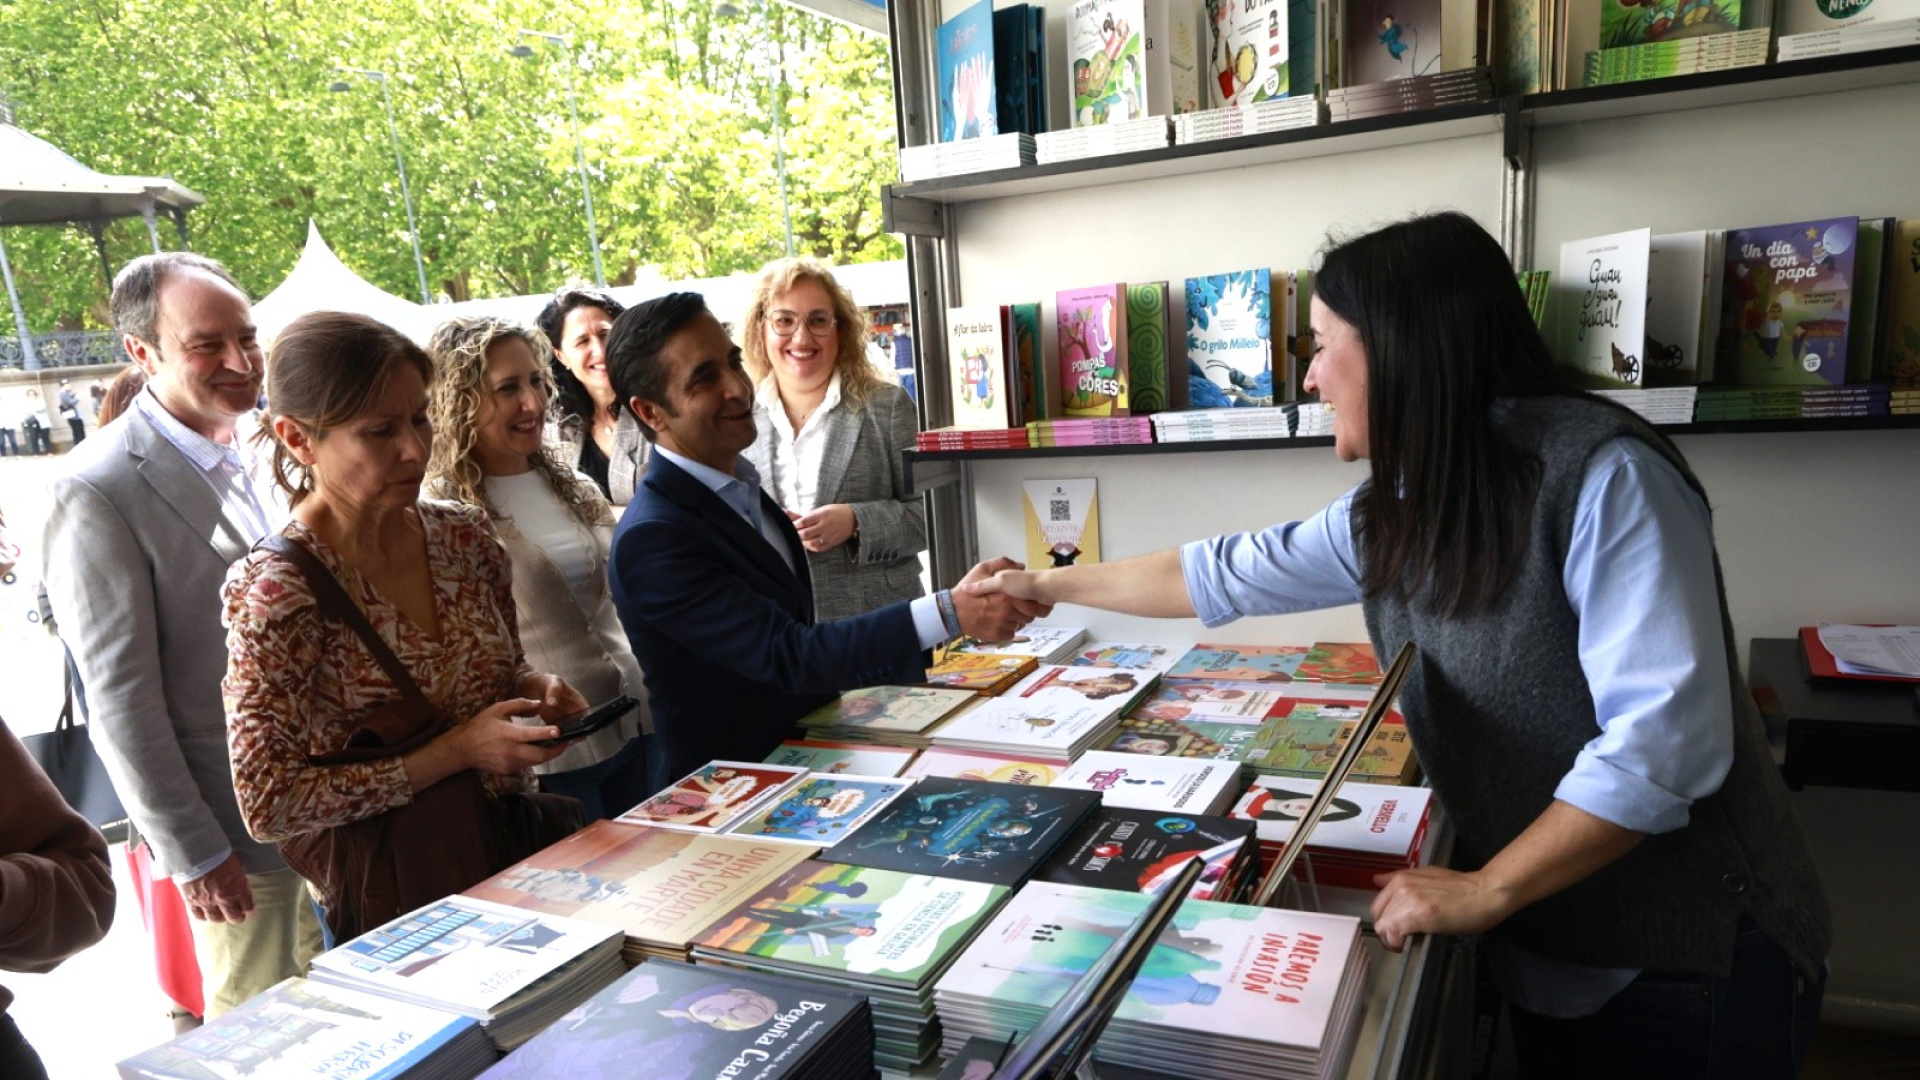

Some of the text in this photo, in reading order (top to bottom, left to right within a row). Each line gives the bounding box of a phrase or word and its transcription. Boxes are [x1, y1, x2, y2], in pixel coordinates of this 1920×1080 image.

[1741, 240, 1794, 258] Un día
[1769, 255, 1799, 268] con
[1775, 262, 1818, 285] papá
[1200, 341, 1207, 351] O
[1208, 339, 1228, 354] grilo
[1079, 375, 1118, 396] CORES
[623, 851, 734, 914] EN MARTE
[639, 847, 780, 930] UNHA CIDADE
[1241, 933, 1288, 994] INVASIÓN
[1274, 932, 1324, 1003] PAREMOS A
[754, 1000, 828, 1046] Begoña
